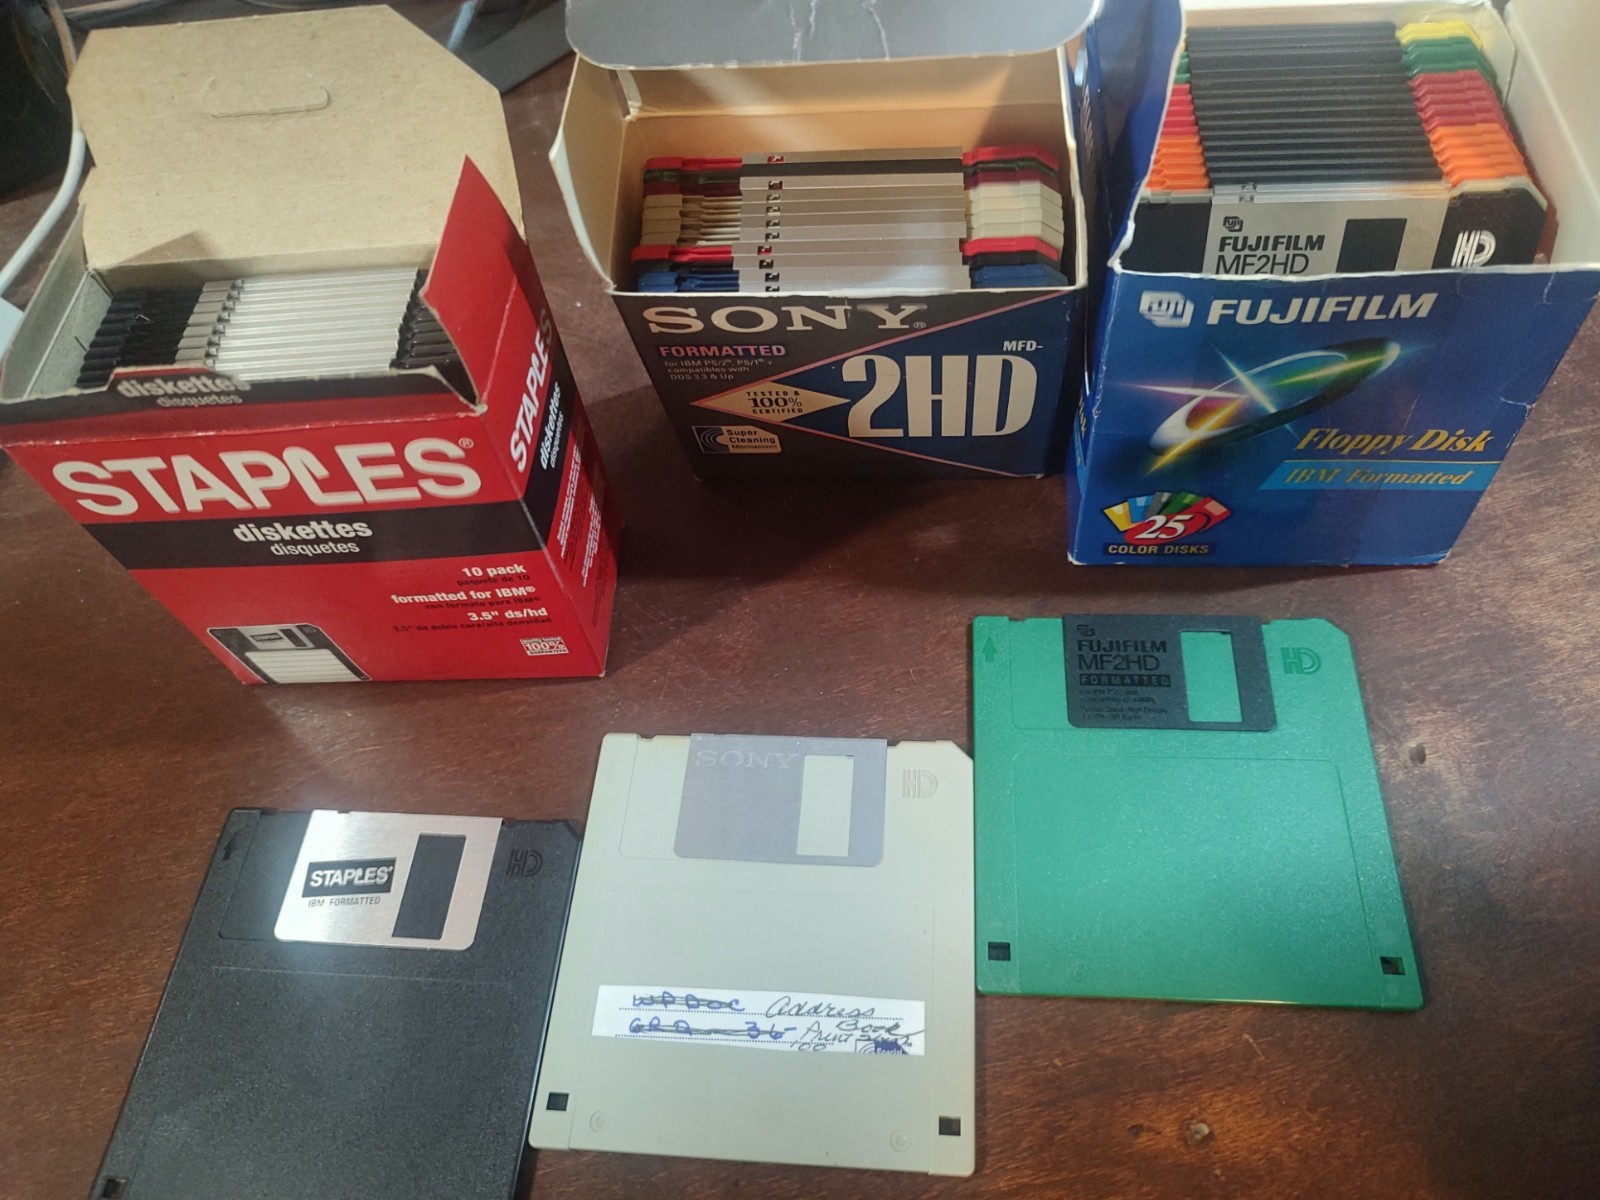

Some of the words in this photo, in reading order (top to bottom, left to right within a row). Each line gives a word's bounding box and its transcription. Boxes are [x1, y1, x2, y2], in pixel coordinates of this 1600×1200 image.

[1219, 235, 1325, 252] FUJIFILM
[1451, 230, 1497, 267] HD
[1215, 254, 1310, 275] MF2HD
[1206, 292, 1438, 325] FUJIFILM
[659, 345, 786, 357] FORMATTED
[1003, 340, 1043, 351] MFD-
[117, 375, 252, 398] diskettes
[510, 308, 552, 473] STAPLES
[156, 394, 243, 408] disquetes
[746, 397, 803, 408] 100%
[841, 355, 1037, 437] 2HD
[540, 381, 561, 470] diskettes
[726, 429, 758, 438] Super
[729, 436, 776, 444] Cleaning
[1294, 427, 1412, 455] Floppy
[1409, 429, 1496, 453] Disk
[1284, 468, 1341, 484] IBM
[1345, 468, 1474, 485] Formatted
[233, 519, 373, 544] diskettes
[1134, 514, 1195, 539] 25
[270, 539, 360, 557] disquetes
[1108, 545, 1158, 554] COLOR
[1163, 545, 1209, 554] DISKS
[461, 566, 484, 578] 10
[486, 563, 527, 578] pack
[391, 590, 468, 604] formatted
[469, 589, 493, 600] for
[467, 609, 499, 622] 3.5"
[505, 606, 548, 620] ds/hd
[525, 641, 565, 651] 100%
[1077, 639, 1167, 653] FUJIFILM
[1078, 653, 1161, 671] MF2HD
[1081, 674, 1170, 686] FORMATTED
[696, 750, 798, 769] SONY
[308, 898, 326, 908] IBM
[329, 896, 381, 907] FORMATTED
